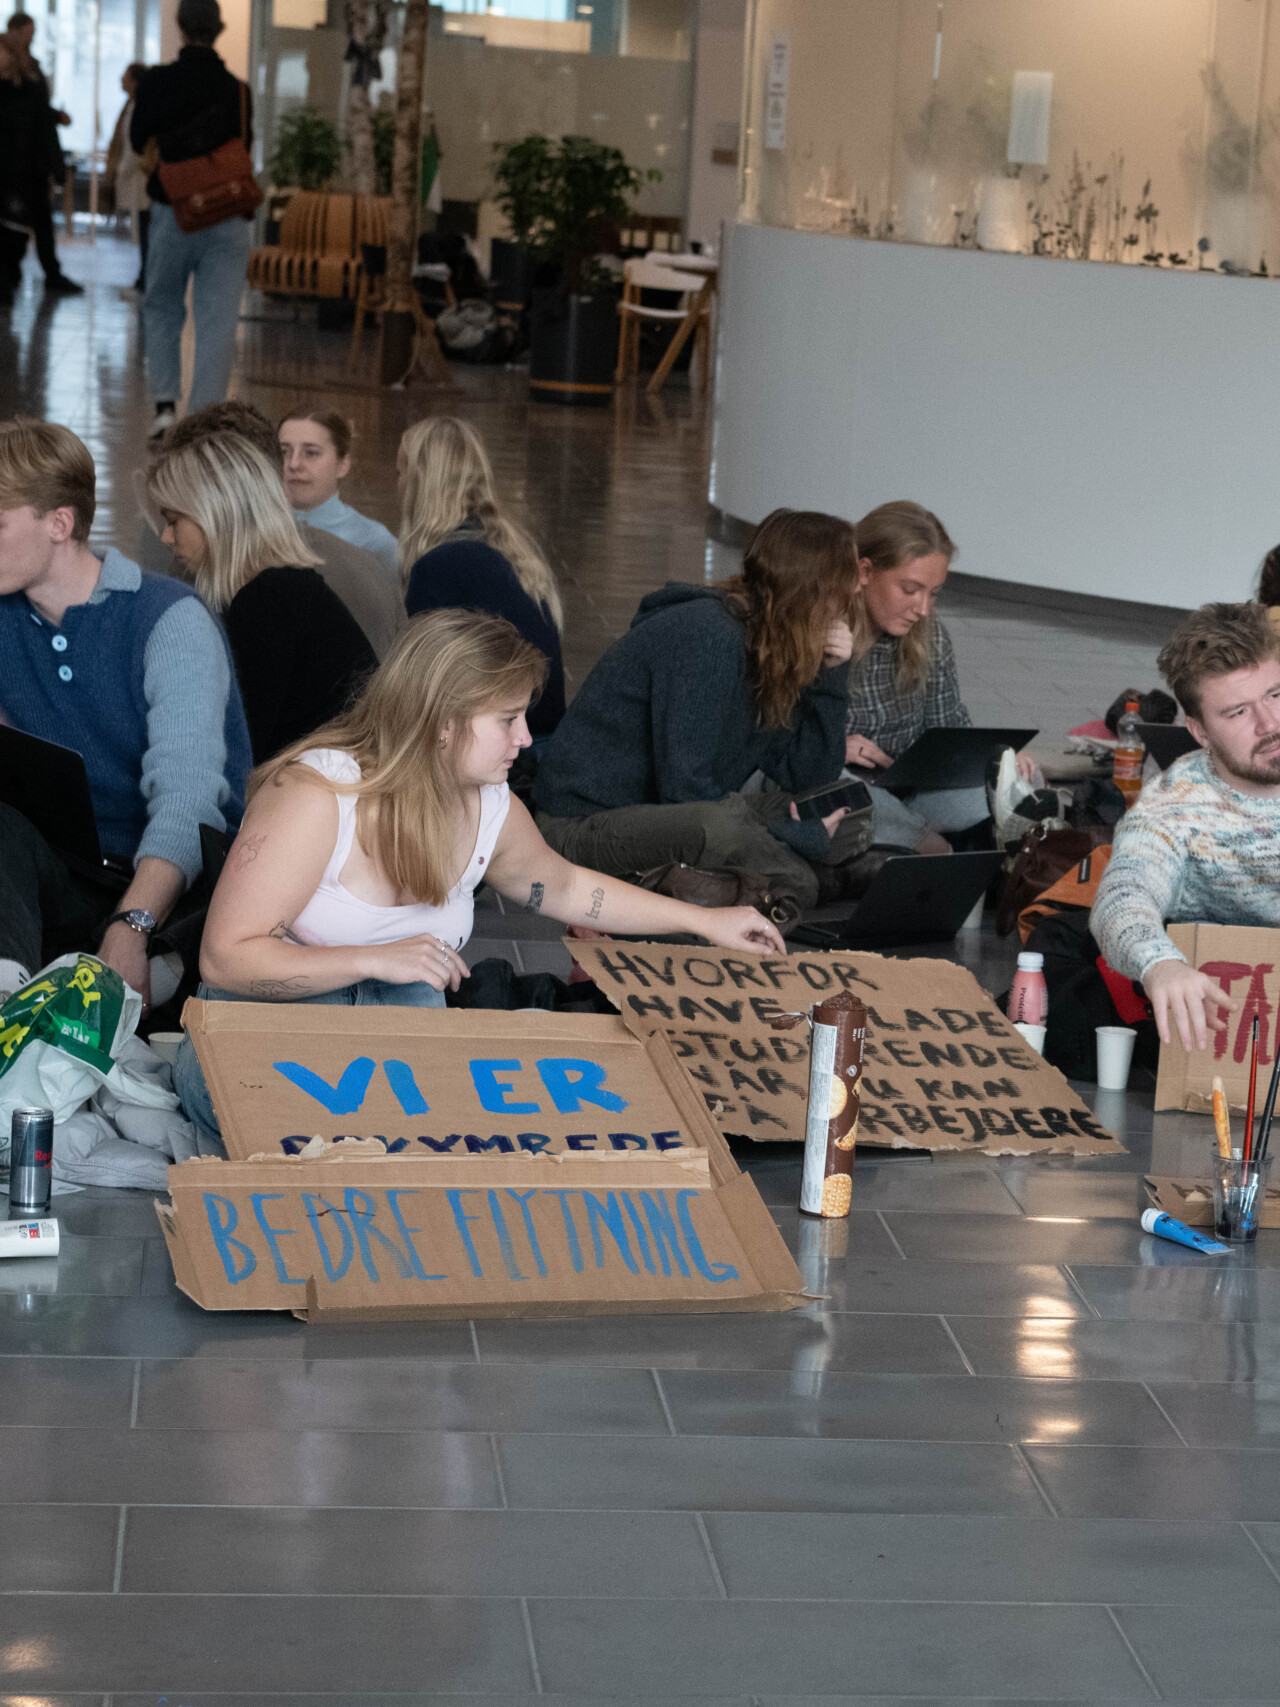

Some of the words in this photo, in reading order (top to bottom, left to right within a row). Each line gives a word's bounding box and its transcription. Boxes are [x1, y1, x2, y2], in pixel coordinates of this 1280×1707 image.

[596, 947, 879, 991] HVORFOR
[627, 994, 785, 1024] HAVE
[864, 1007, 1010, 1038] LADE
[1018, 987, 1026, 1020] Protein
[650, 1028, 1038, 1071] STUDRENDE
[273, 1056, 430, 1116] VI
[469, 1058, 630, 1115] ER
[916, 1077, 1022, 1101] KAN
[279, 1130, 685, 1156] BKYMREDE
[858, 1102, 1113, 1142] RBEJDERE
[202, 1187, 448, 1285] BEDRE
[445, 1187, 740, 1283] FLYTNING
